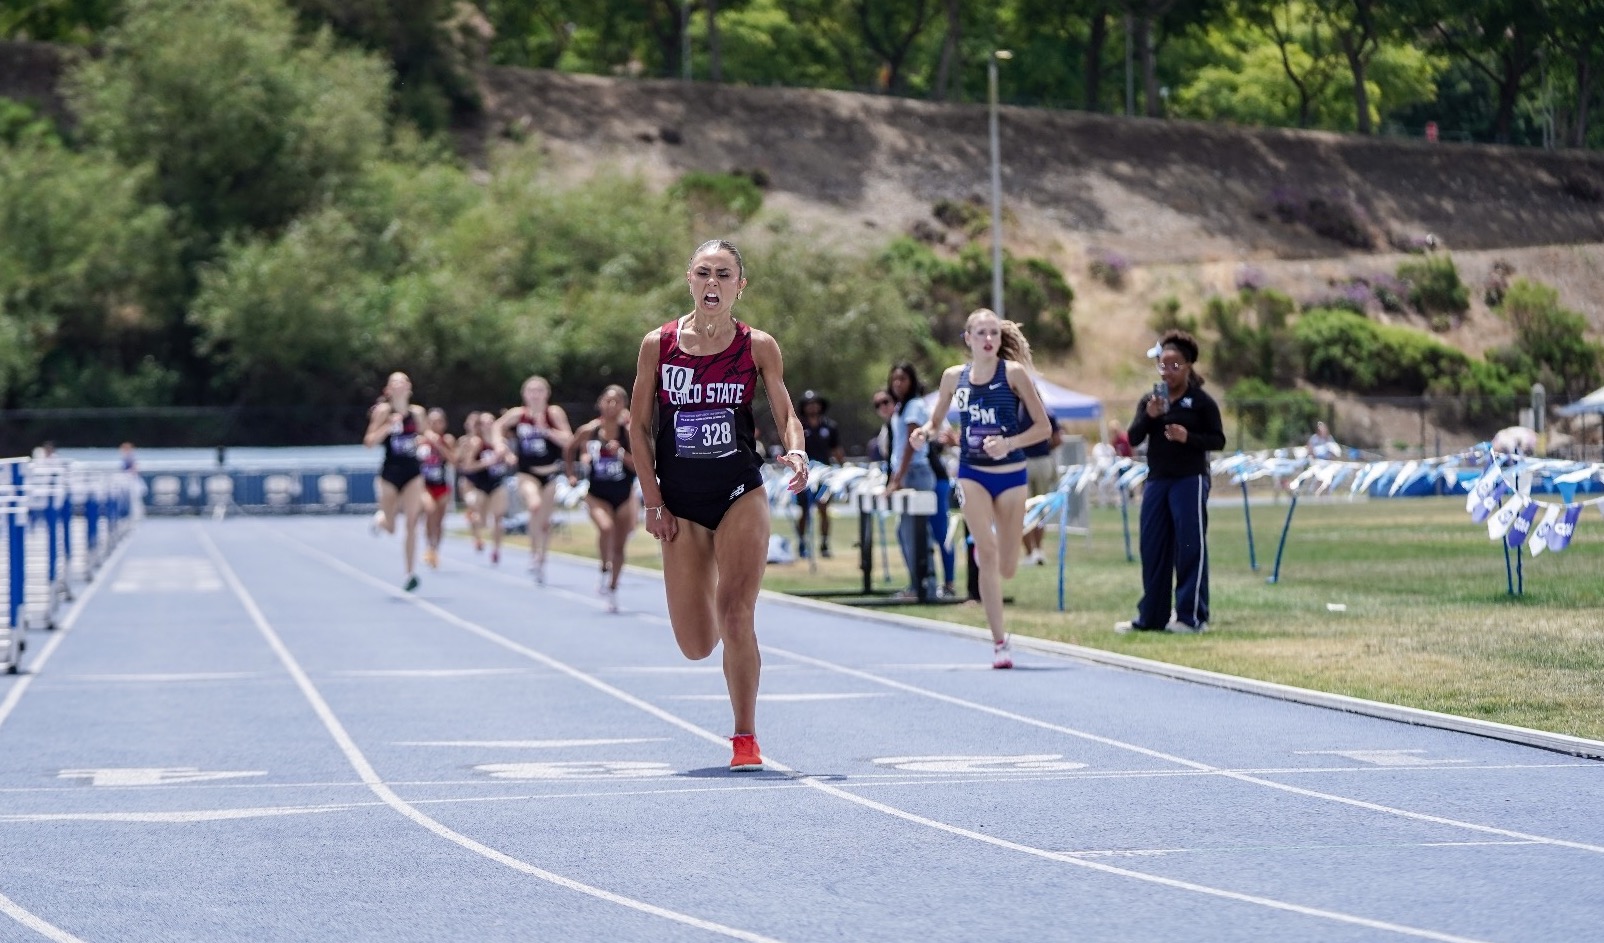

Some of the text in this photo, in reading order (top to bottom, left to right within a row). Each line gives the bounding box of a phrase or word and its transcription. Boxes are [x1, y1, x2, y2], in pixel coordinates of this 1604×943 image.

[666, 367, 686, 391] 10
[706, 383, 744, 404] STATE
[969, 404, 996, 425] SM
[701, 422, 732, 447] 328
